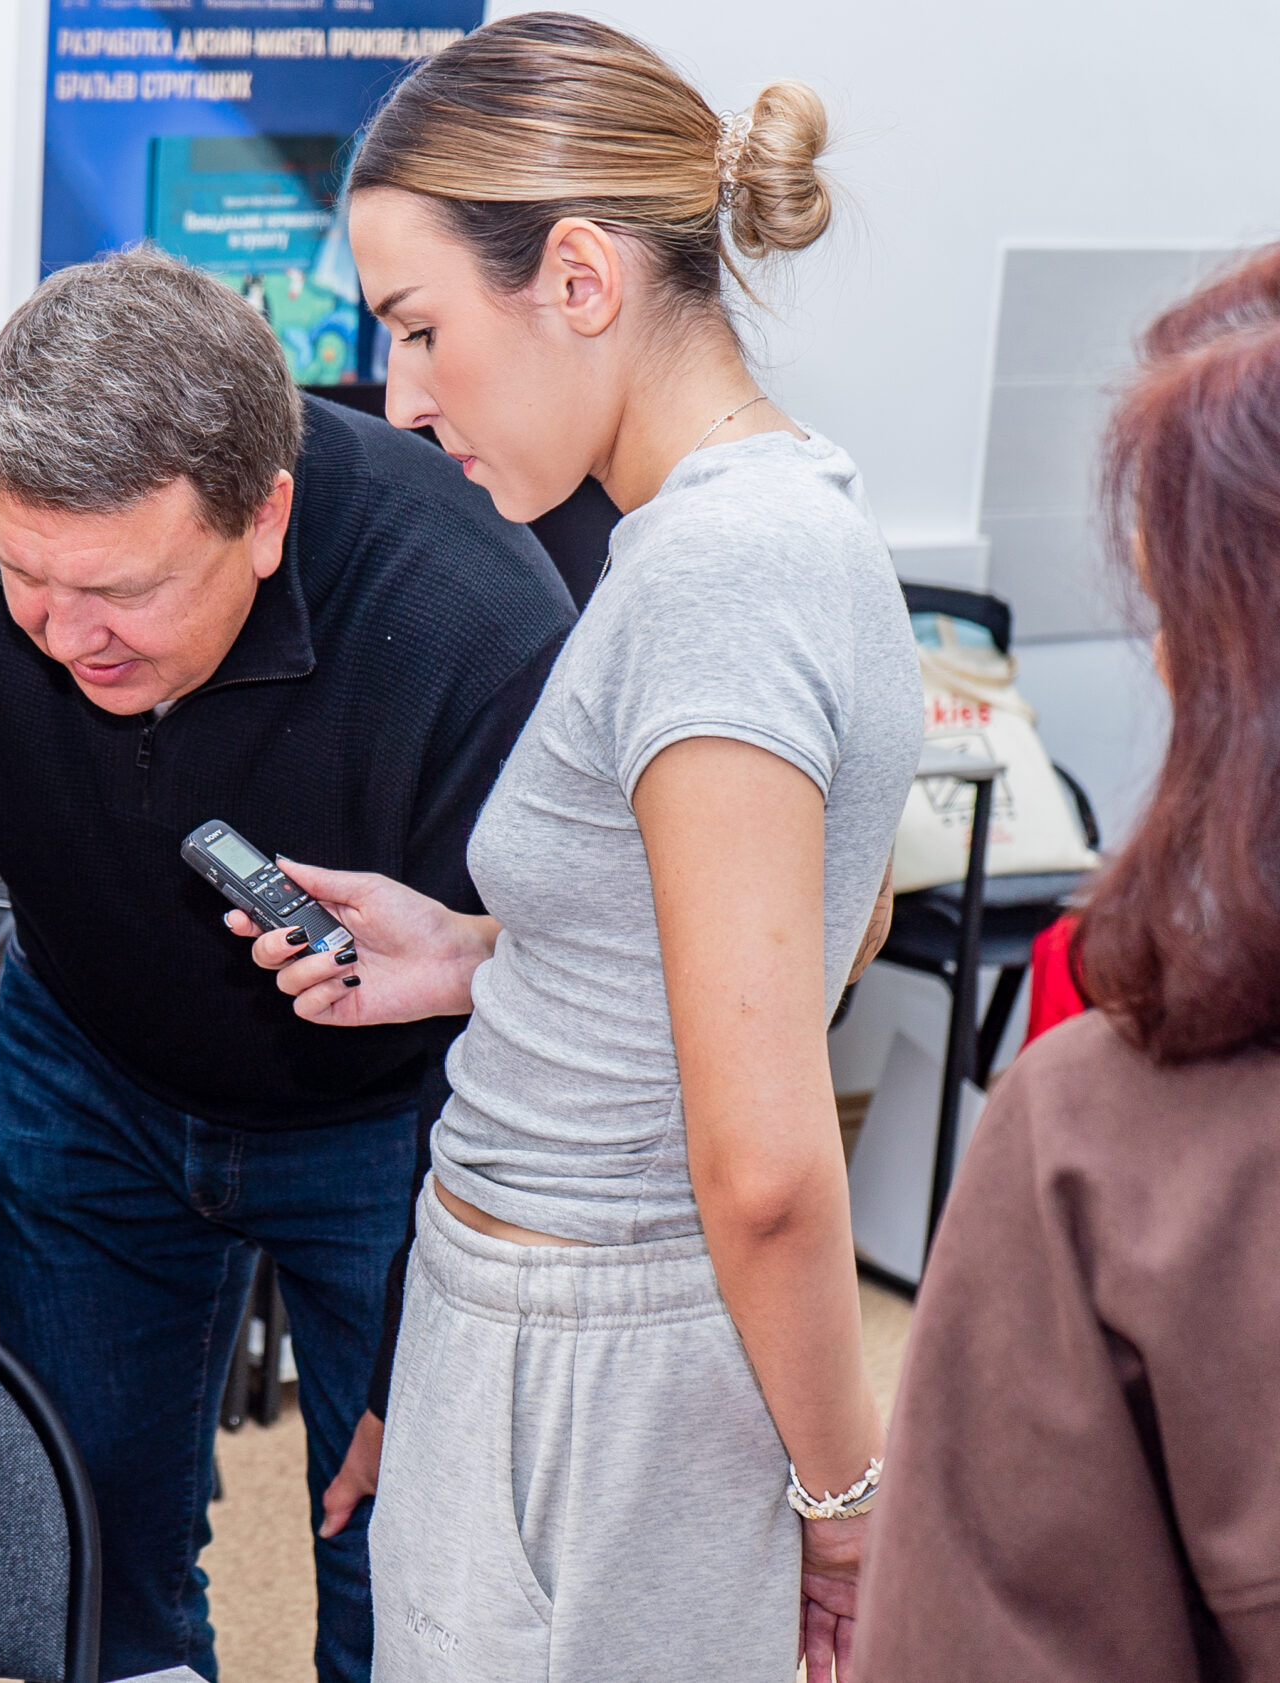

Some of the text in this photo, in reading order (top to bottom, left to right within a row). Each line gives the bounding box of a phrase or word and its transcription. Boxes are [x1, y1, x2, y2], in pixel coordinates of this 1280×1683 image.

[56, 27, 173, 57] РАЗРАБОТКА
[327, 27, 465, 60] ПРОИЗВЕДЕНИ
[54, 70, 253, 100] БРАТЬЕВ СТРУГАЦКИХ
[204, 828, 223, 843] SONY
